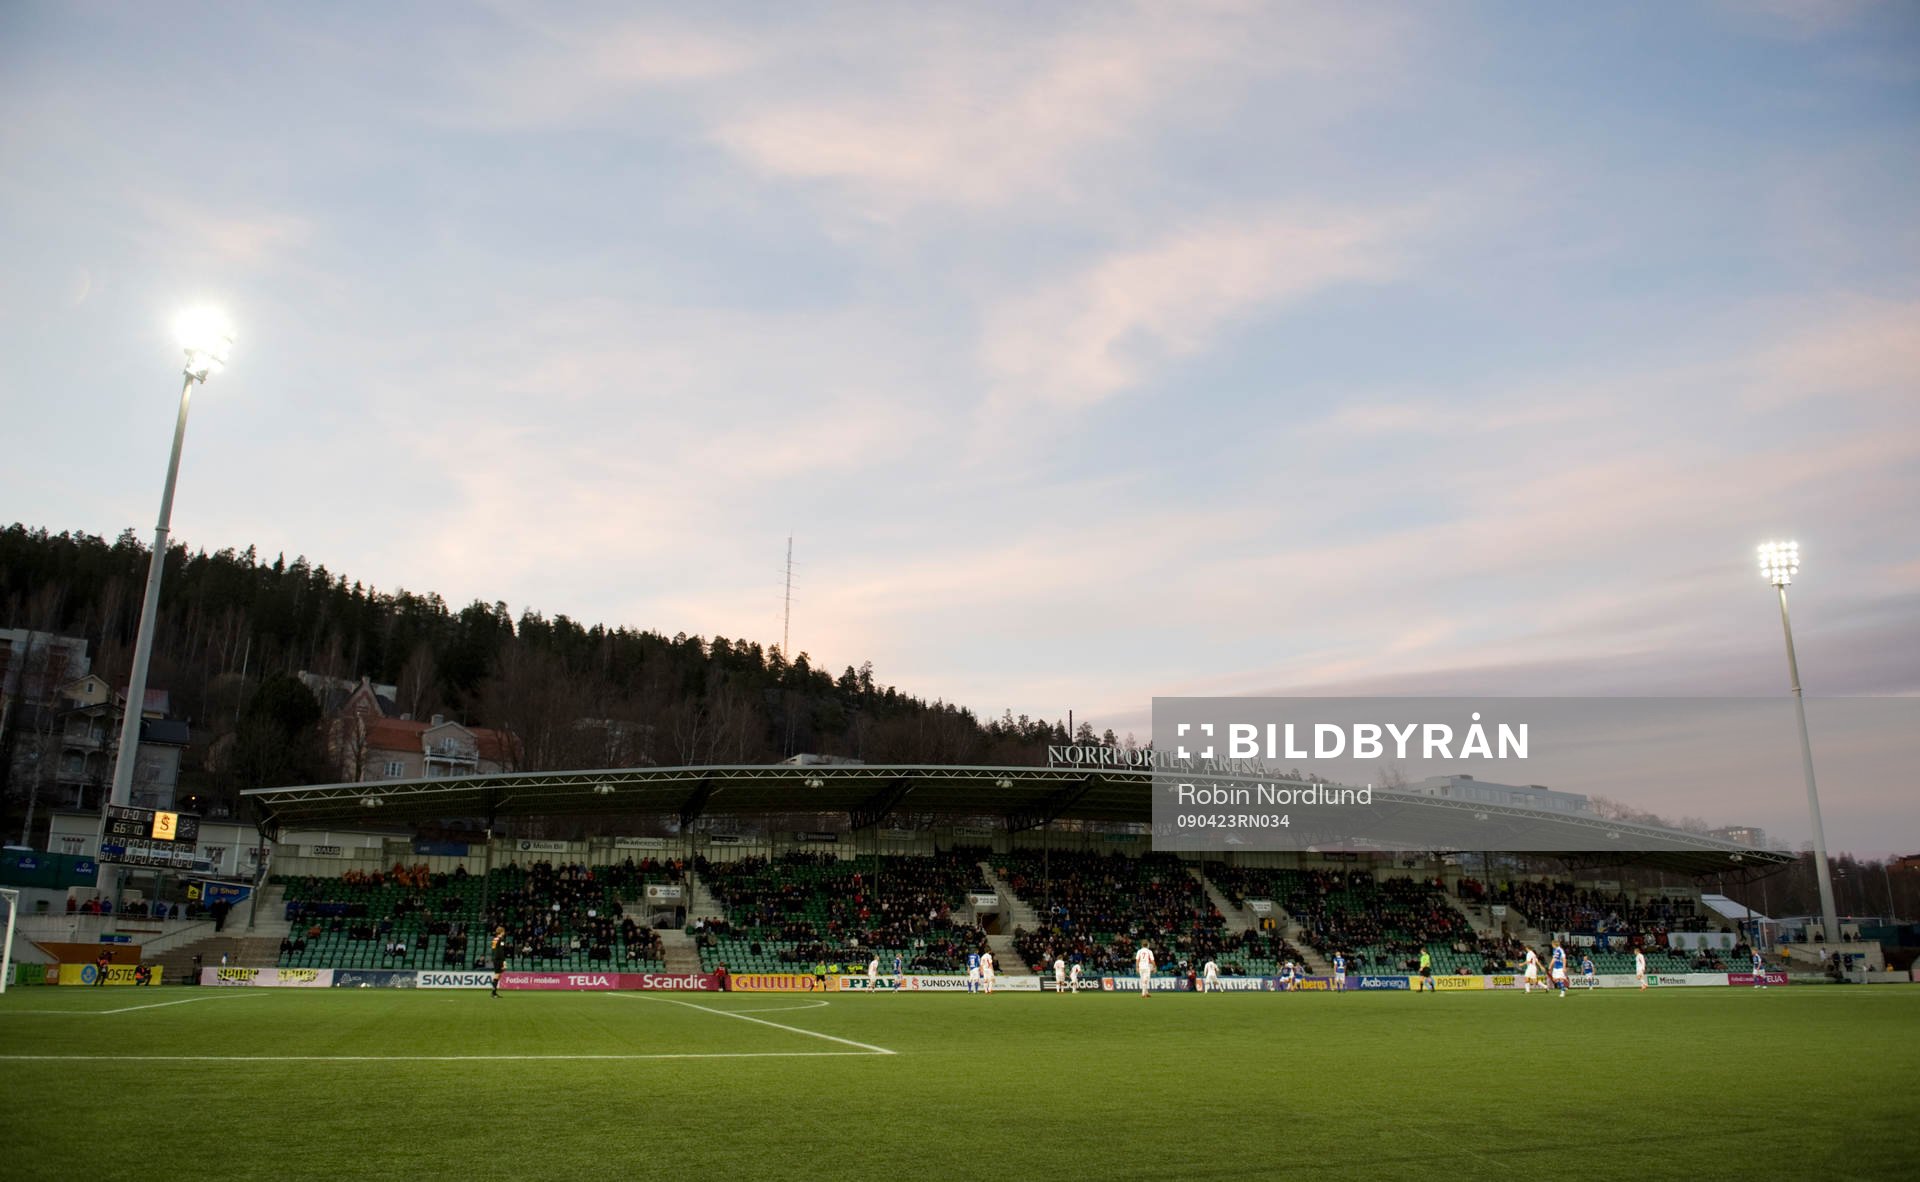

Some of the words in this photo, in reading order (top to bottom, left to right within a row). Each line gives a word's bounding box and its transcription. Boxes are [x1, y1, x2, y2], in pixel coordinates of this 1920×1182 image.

[1047, 745, 1195, 769] NORRPORTEN
[422, 974, 493, 986] SKANSKA
[643, 974, 707, 989] Scandic
[922, 979, 968, 988] SUNDSVAL
[1116, 979, 1176, 990] STRYIPSET
